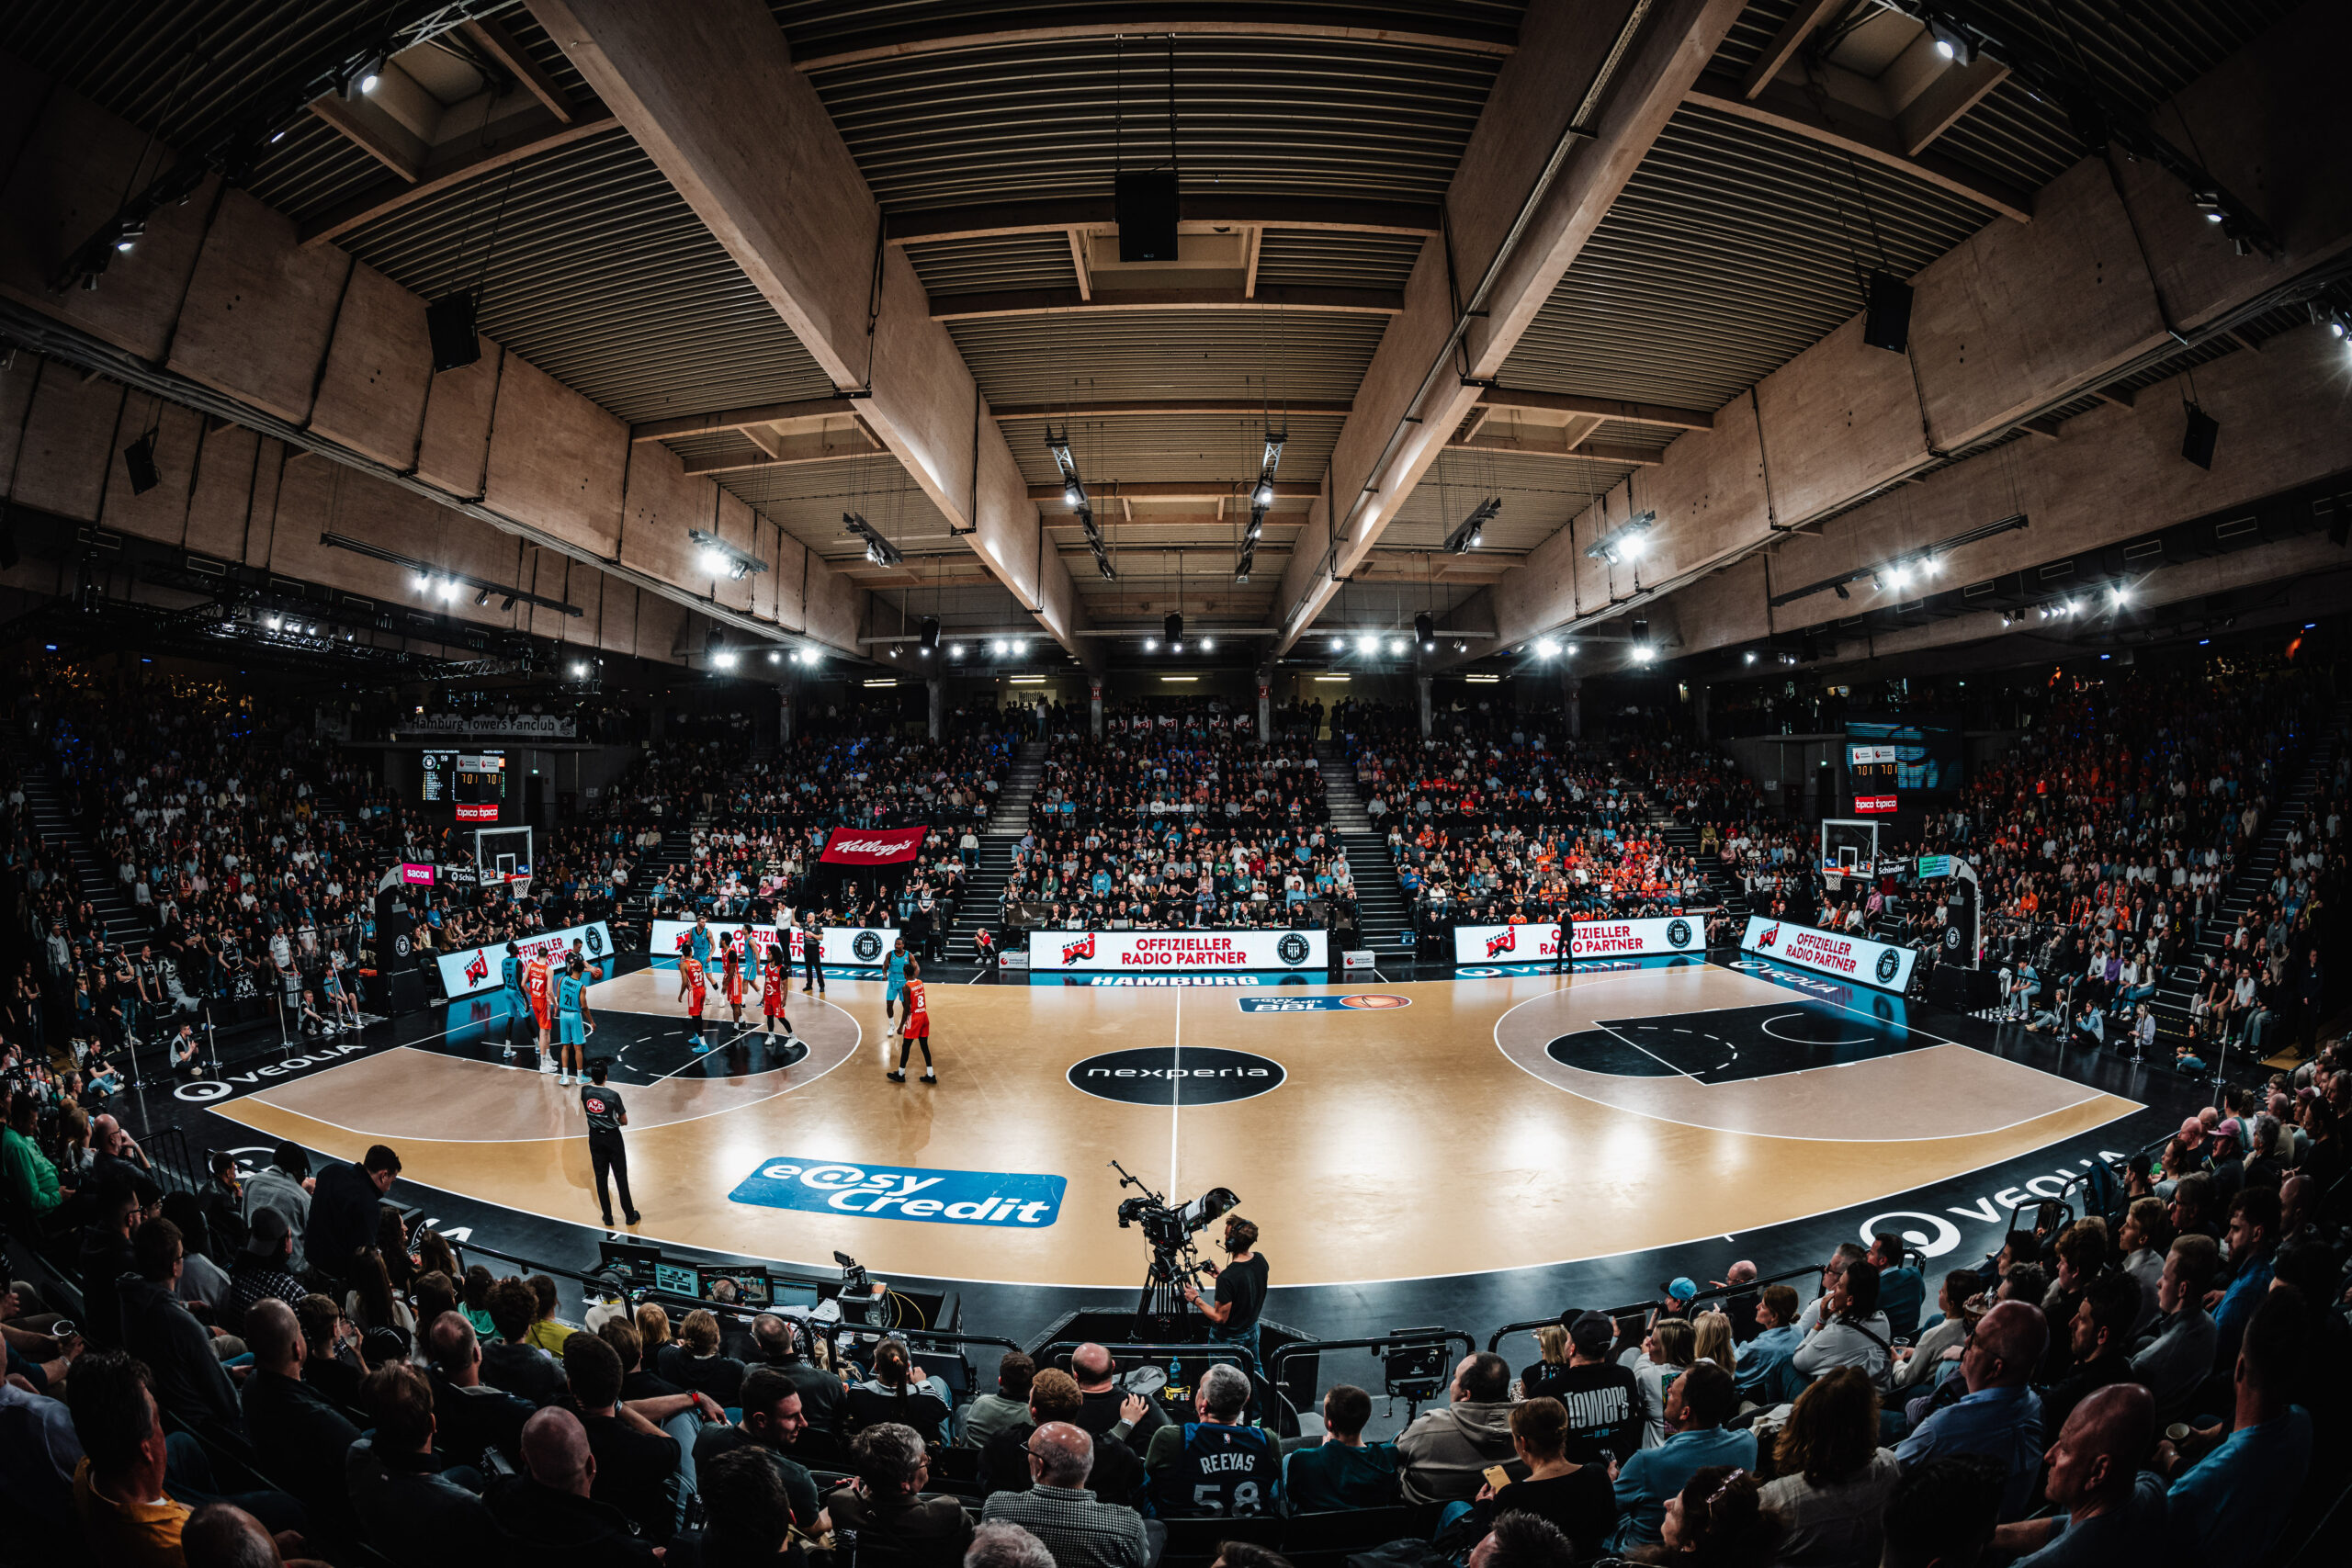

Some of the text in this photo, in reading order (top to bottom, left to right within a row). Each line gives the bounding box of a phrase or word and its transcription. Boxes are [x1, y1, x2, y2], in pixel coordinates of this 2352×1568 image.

[413, 717, 555, 732] Hamburg Towers Fanclub
[1856, 798, 1874, 809] tipico
[1875, 797, 1896, 809] tipico
[457, 807, 479, 818] tipico
[480, 807, 498, 818] tipico
[834, 839, 913, 856] Kellogg's
[1878, 864, 1905, 874] Schindler
[516, 937, 564, 960] FFIZIELLER
[1136, 938, 1232, 951] OFFIZIELLER
[1540, 938, 1644, 954] RAO PARTNER
[1797, 932, 1851, 956] OFFIZIELLER
[1122, 952, 1247, 964] RADIO PARTNER
[1785, 943, 1814, 962] RADIO
[1813, 951, 1857, 974] PARTNER
[531, 977, 544, 991] 17
[1091, 976, 1260, 987] HAMBURG
[1759, 967, 1839, 993] VEOLIA
[564, 994, 572, 1007] 21
[917, 995, 924, 1008] 8
[226, 1043, 368, 1083] VEOLIA
[1087, 1066, 1269, 1080] nexperia
[827, 1187, 1051, 1224] Credit
[1199, 1452, 1256, 1474] REEYAS
[1193, 1481, 1261, 1518] 58
